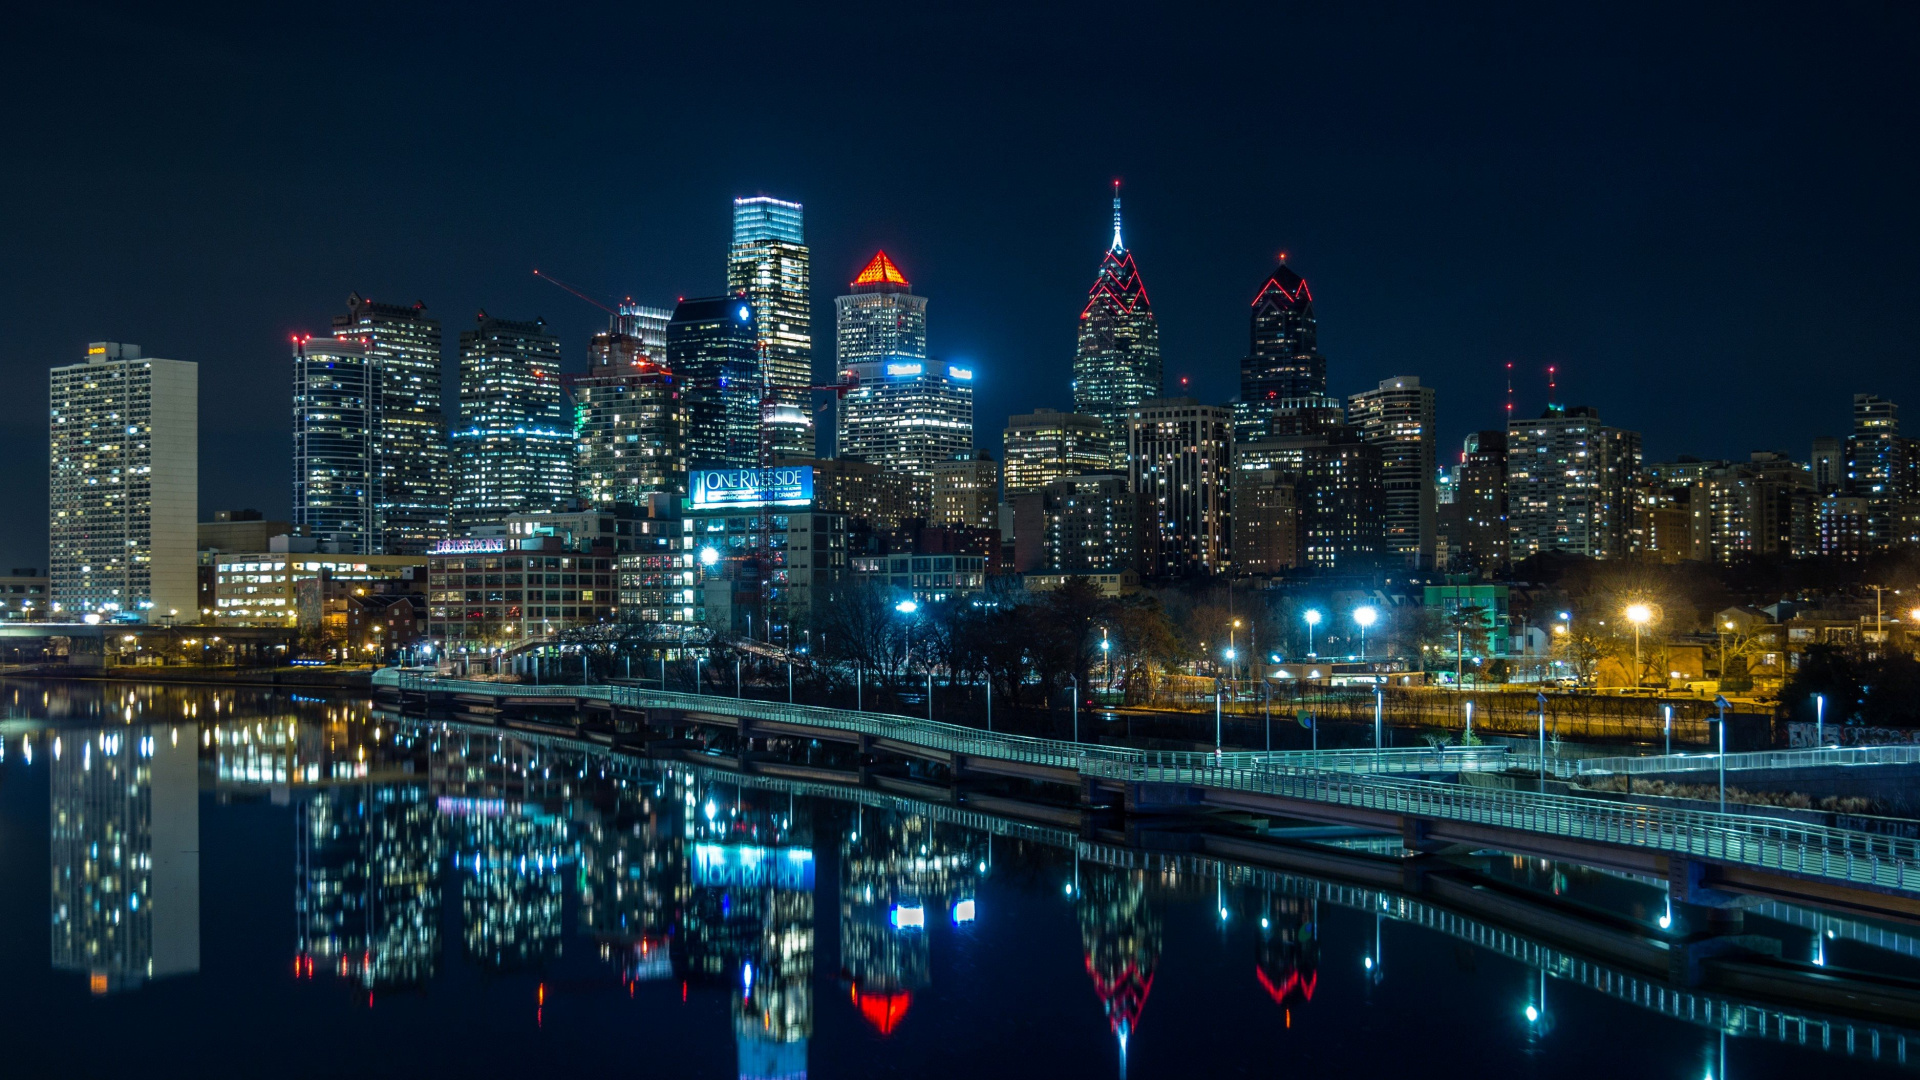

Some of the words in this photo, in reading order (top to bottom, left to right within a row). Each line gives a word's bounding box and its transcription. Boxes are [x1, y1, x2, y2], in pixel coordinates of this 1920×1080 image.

[706, 472, 738, 490] ONE
[740, 470, 802, 490] RIVERSIDE
[474, 539, 504, 551] POINT
